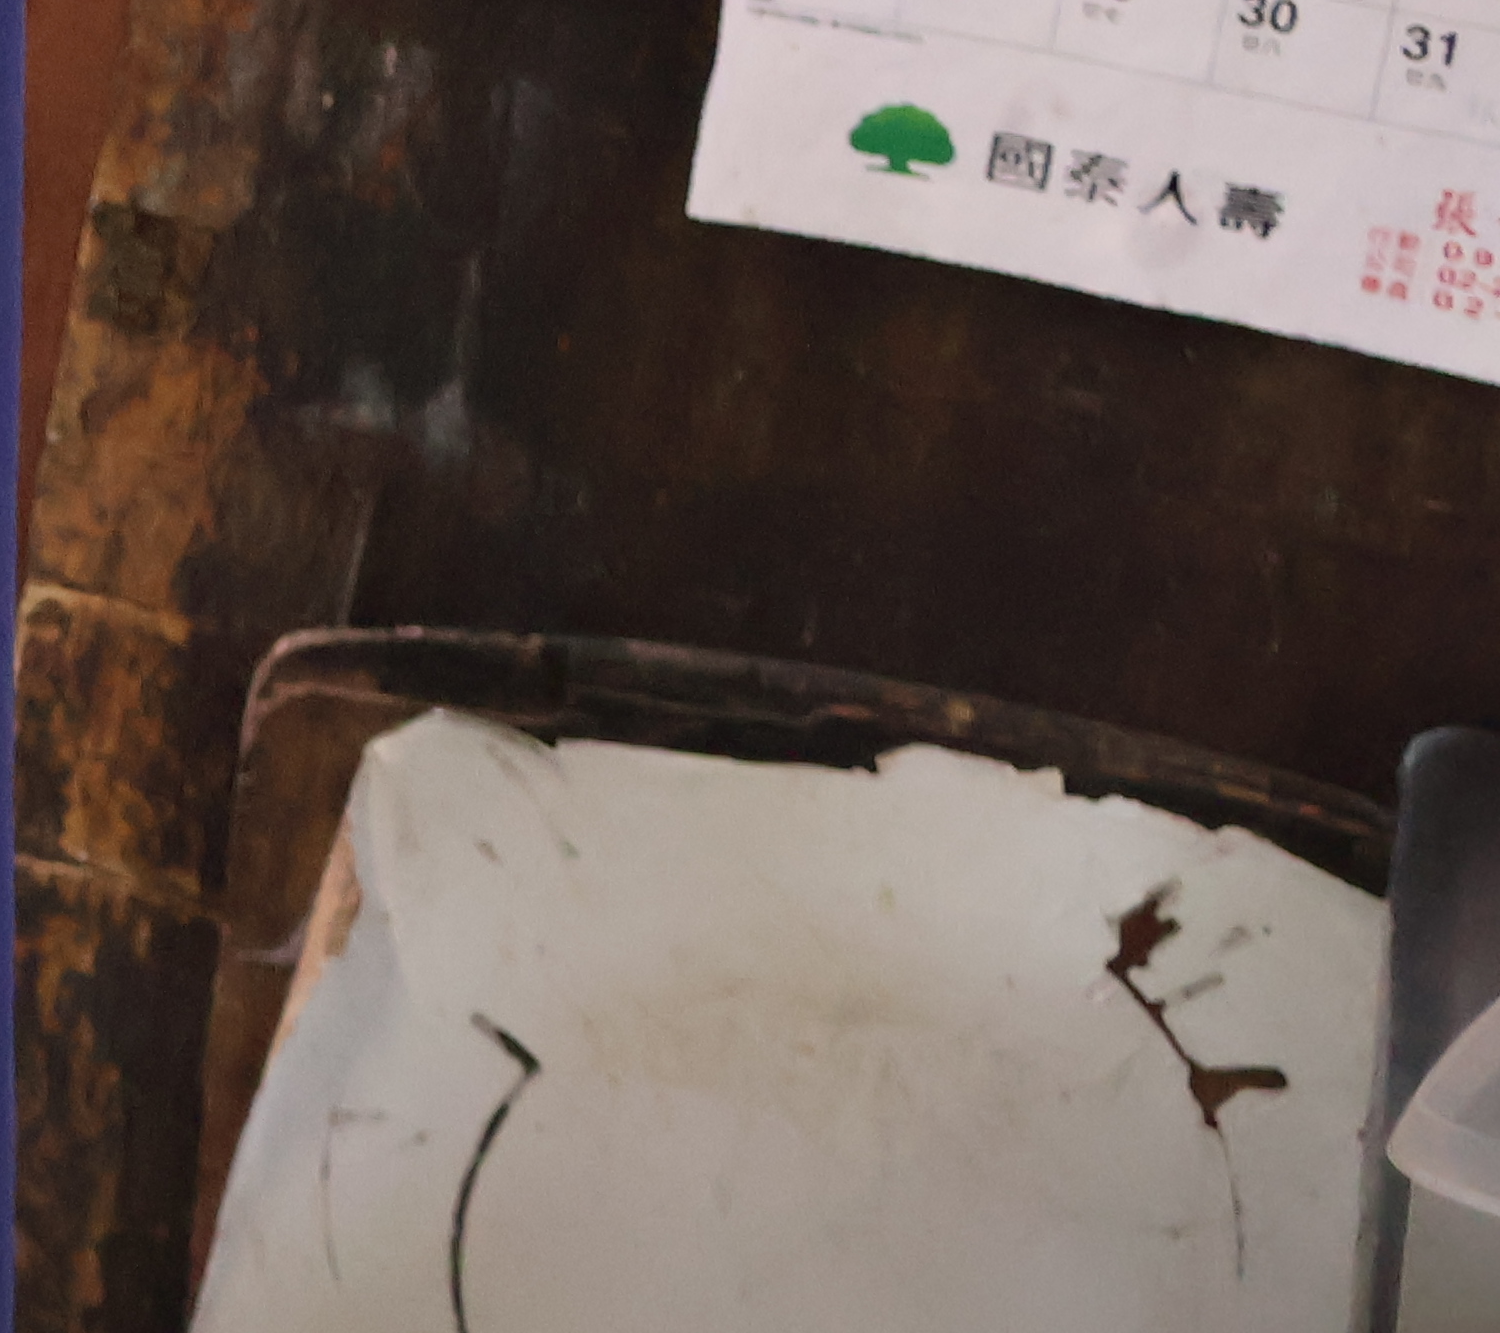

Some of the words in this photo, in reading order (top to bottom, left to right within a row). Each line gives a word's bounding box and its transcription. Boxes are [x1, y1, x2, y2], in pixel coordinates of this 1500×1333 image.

[1402, 24, 1459, 68] 31
[986, 130, 1287, 240] 國泰人壽
